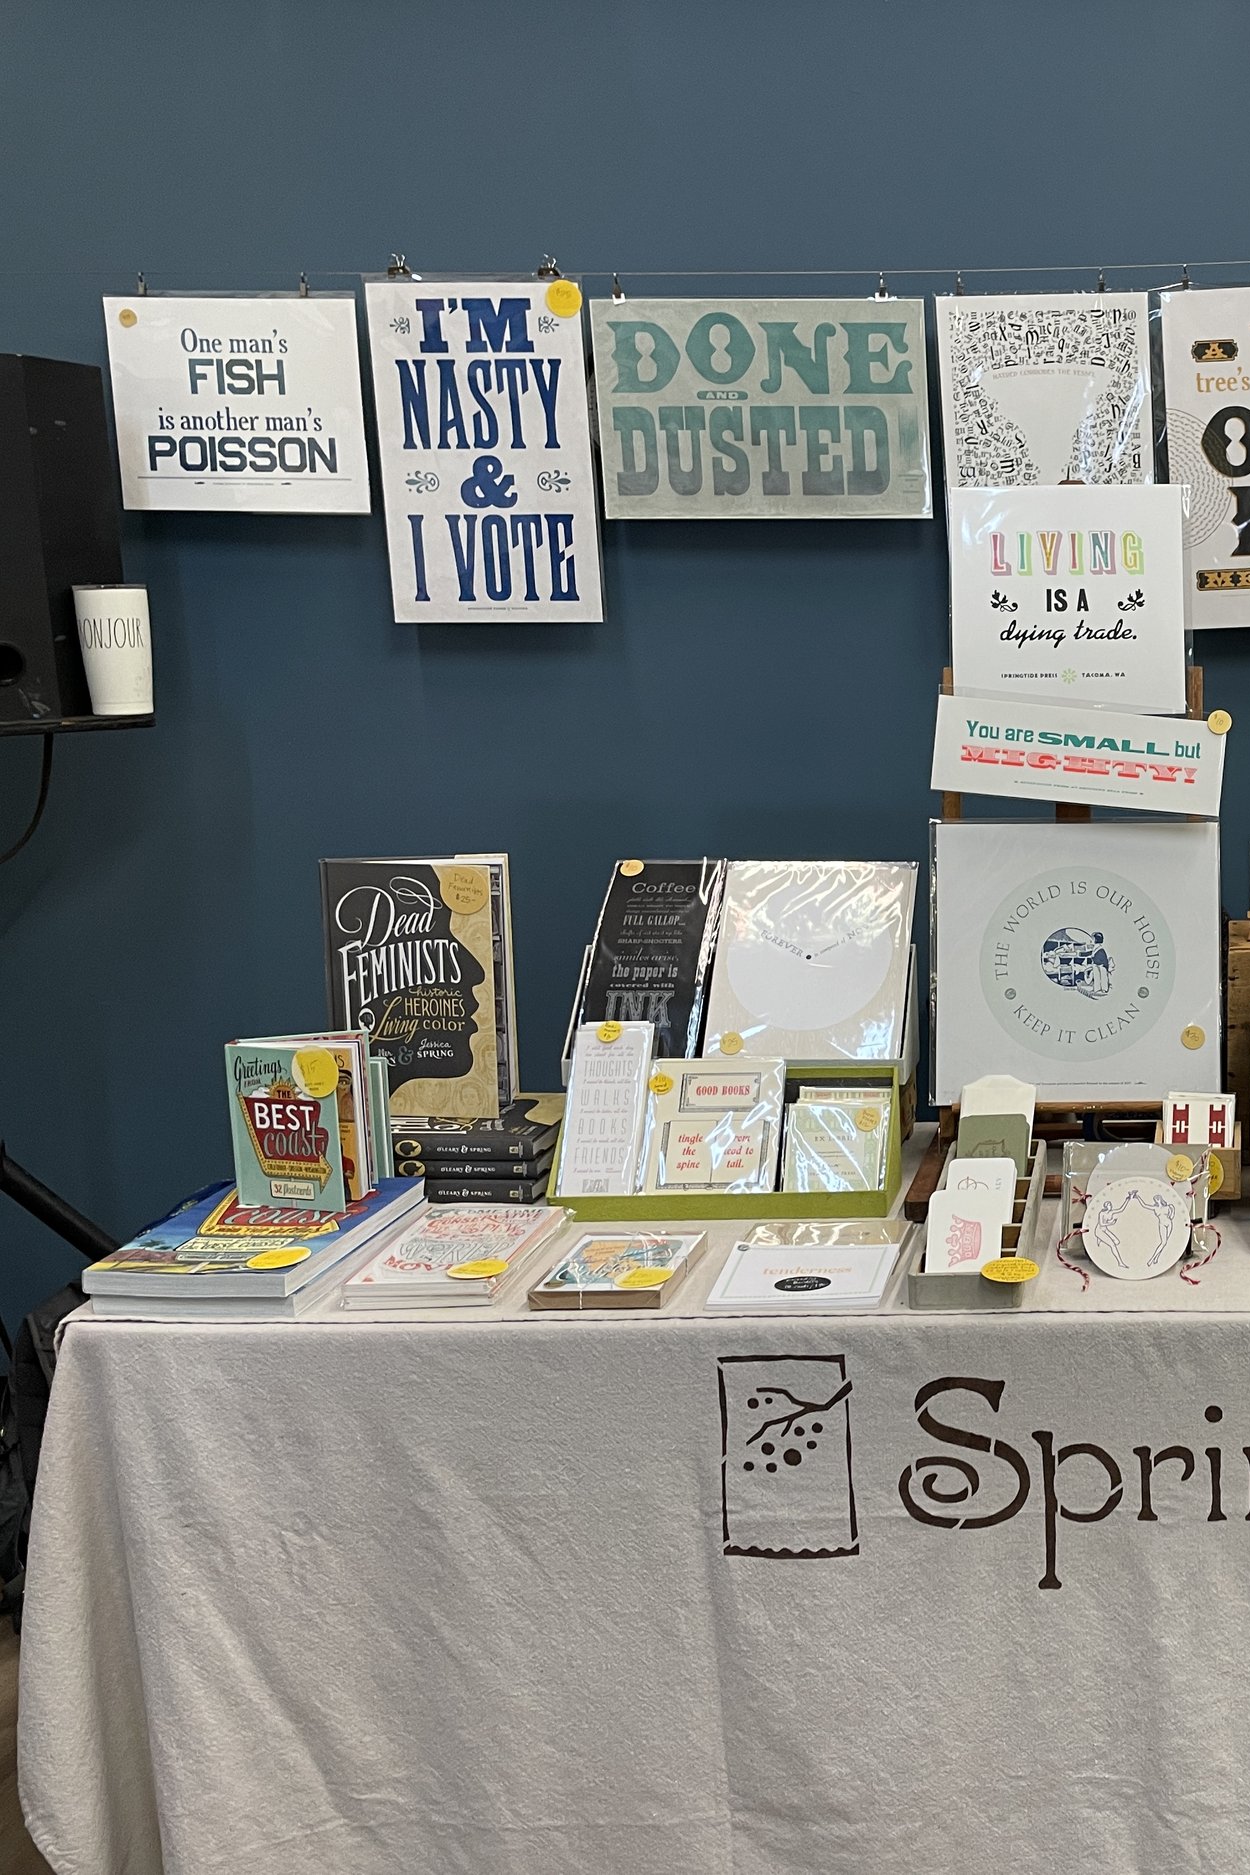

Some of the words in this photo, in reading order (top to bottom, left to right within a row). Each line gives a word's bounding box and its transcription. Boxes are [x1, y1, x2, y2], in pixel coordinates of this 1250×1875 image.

[415, 298, 535, 353] I'M
[181, 328, 222, 354] One
[229, 328, 288, 354] man's
[606, 311, 914, 395] DONE
[1204, 342, 1227, 361] A
[188, 359, 286, 396] FISH
[1196, 366, 1250, 394] tree's
[395, 358, 562, 451] NASTY
[705, 391, 739, 400] AND
[158, 407, 176, 432] is
[180, 408, 259, 433] another
[265, 408, 323, 434] man's
[147, 435, 338, 474] POISSON
[612, 405, 891, 497] DUSTED
[459, 455, 518, 508] &
[406, 514, 432, 602] I
[445, 513, 580, 603] VOTE
[989, 530, 1145, 576] LIVING
[1045, 588, 1070, 613] IS
[1076, 588, 1090, 612] A
[998, 620, 1067, 649] dying
[1073, 619, 1138, 641] trade.
[966, 720, 1000, 740] You
[1004, 728, 1035, 743] are
[1037, 731, 1171, 757] SMALL
[1174, 740, 1201, 760] but
[960, 744, 1199, 784] MIGHTY!
[631, 882, 697, 894] Coffee
[335, 876, 443, 949] Dead
[622, 914, 644, 926] FULL
[994, 941, 1010, 980] THE
[1003, 883, 1062, 935] WORLD
[1070, 880, 1088, 895] IS
[1095, 885, 1133, 915] OUR
[1133, 915, 1160, 981] HOUSE
[337, 938, 463, 1031] FEMINISTS
[612, 963, 630, 978] the
[632, 965, 665, 981] paper
[667, 963, 679, 978] is
[408, 985, 463, 998] historic
[369, 996, 420, 1044] Living
[422, 1017, 466, 1032] color
[404, 997, 466, 1017] HEROINES
[605, 989, 675, 1028] INK
[1012, 1003, 1051, 1037] KEEP
[1057, 1029, 1077, 1044] IT
[1084, 1002, 1141, 1044] CLEAN
[416, 1049, 454, 1059] SPRING
[418, 1037, 452, 1051] Jessica
[233, 1055, 287, 1092] Greetings
[276, 1089, 292, 1099] THE
[695, 1085, 719, 1096] GOOD
[721, 1085, 751, 1096] BOOKS
[254, 1102, 314, 1132] BEST
[263, 1121, 325, 1157] coast
[460, 1145, 469, 1154] &
[678, 1133, 704, 1145] tingle
[682, 1146, 696, 1155] the
[676, 1160, 700, 1171] spine
[726, 1159, 744, 1168] tail.
